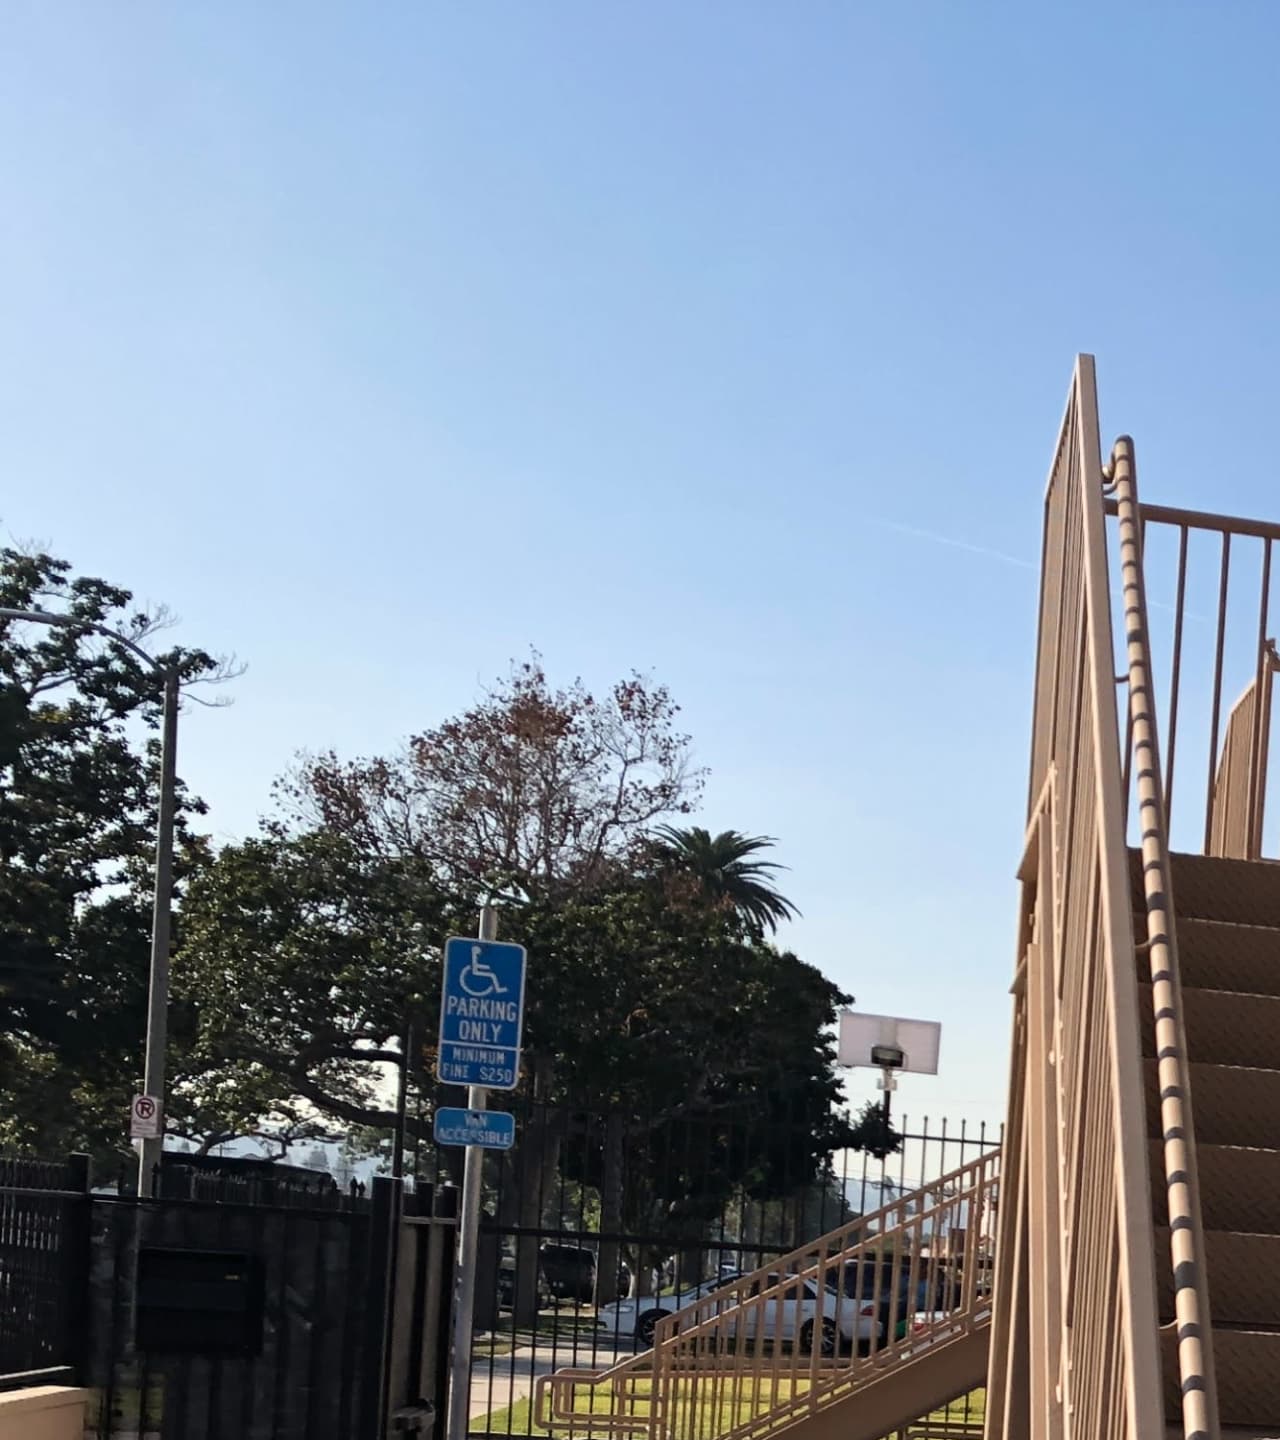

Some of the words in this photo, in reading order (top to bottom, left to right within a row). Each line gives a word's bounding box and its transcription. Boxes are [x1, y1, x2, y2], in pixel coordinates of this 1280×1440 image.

[446, 995, 518, 1022] PARKING
[458, 1020, 502, 1042] ONLY
[452, 1047, 505, 1064] MINIMUM
[443, 1063, 470, 1079] FINE
